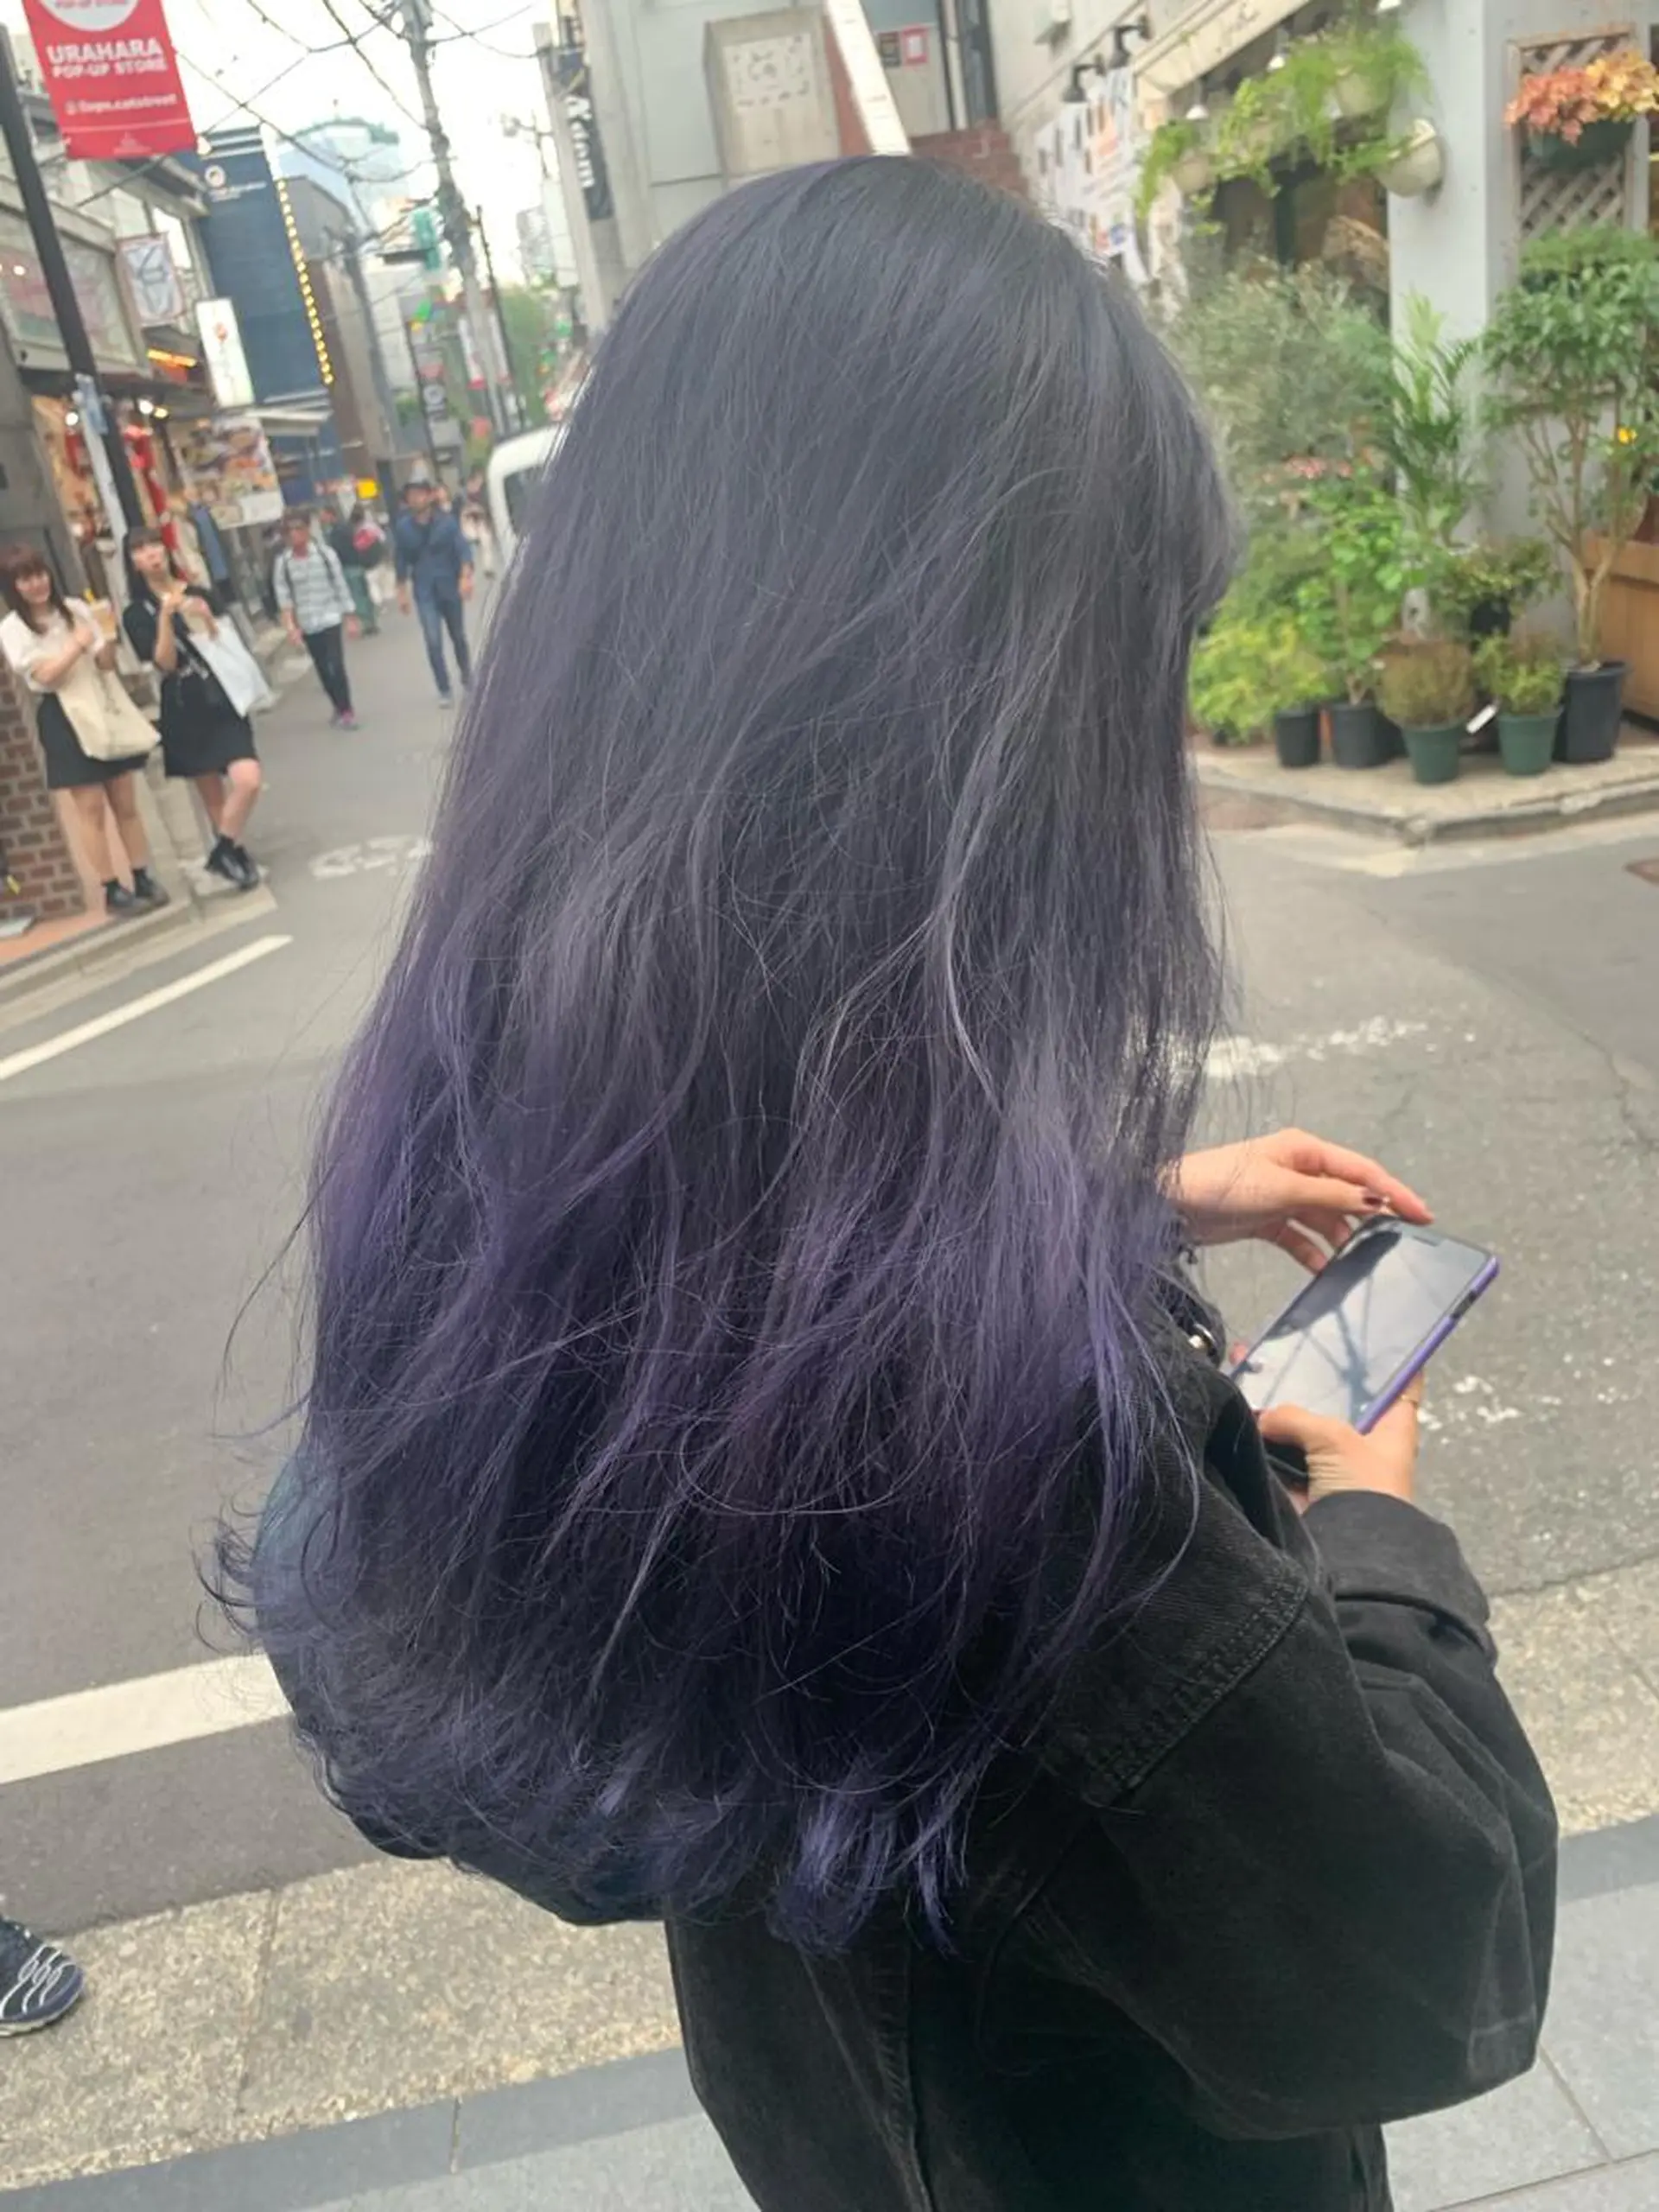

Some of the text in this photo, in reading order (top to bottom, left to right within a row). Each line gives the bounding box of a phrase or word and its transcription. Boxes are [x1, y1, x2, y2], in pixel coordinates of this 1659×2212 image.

[46, 37, 164, 65] URAHARA
[52, 57, 168, 79] POP-UP STORE
